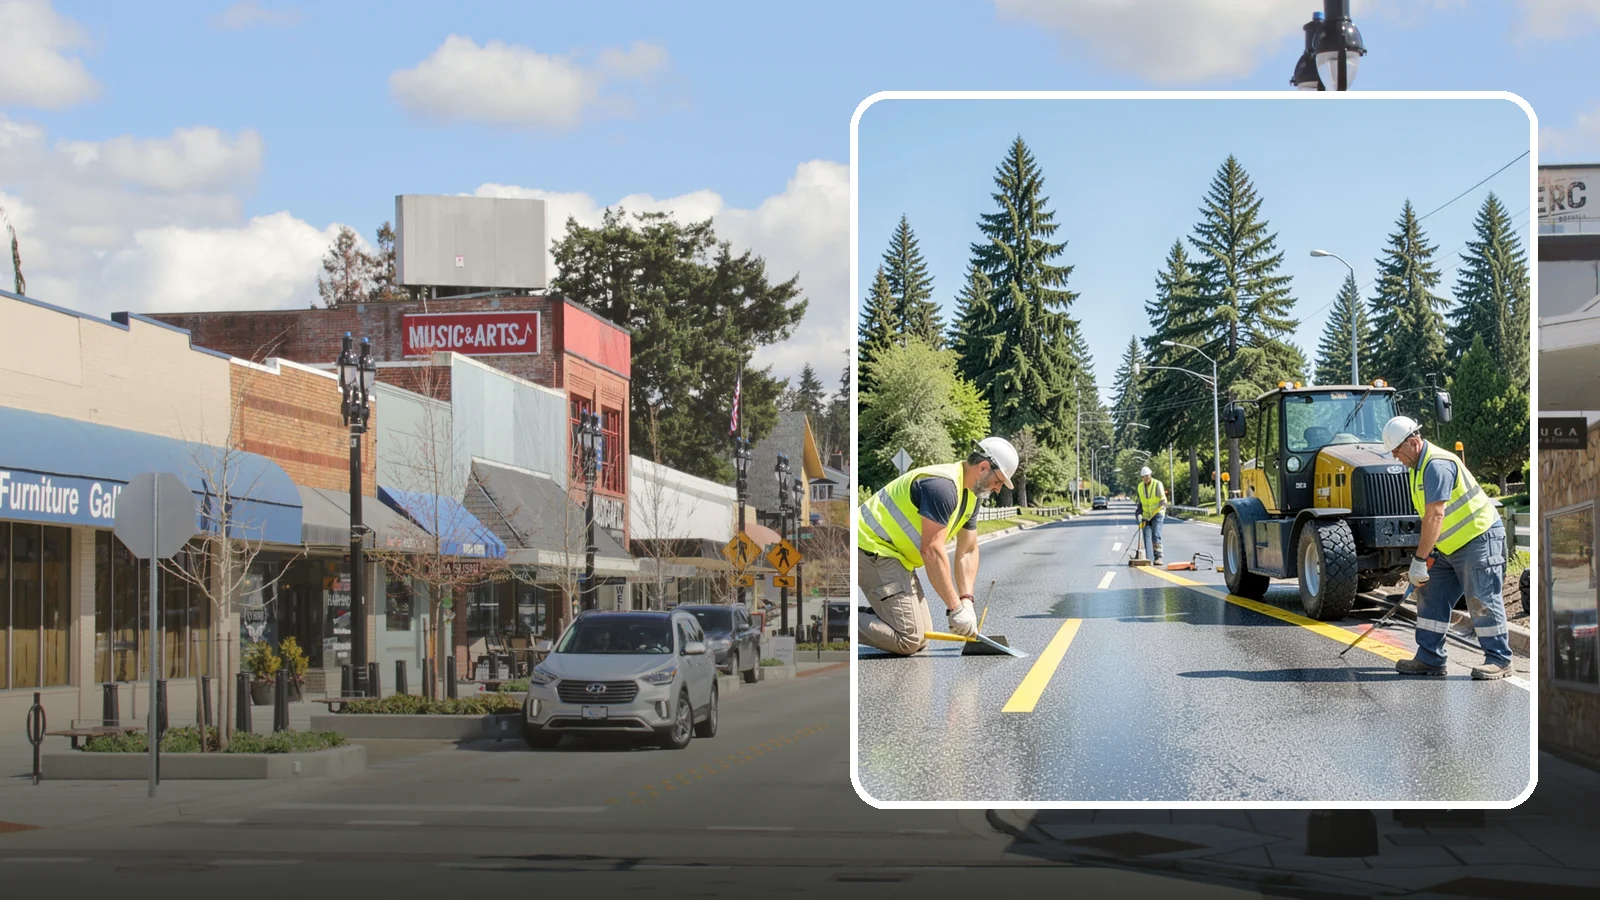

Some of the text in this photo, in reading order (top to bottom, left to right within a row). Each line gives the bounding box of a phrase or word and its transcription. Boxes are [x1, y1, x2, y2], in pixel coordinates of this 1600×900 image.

[1540, 427, 1577, 437] UGA
[0, 471, 121, 519] Furniture Gal
[453, 563, 478, 574] SUSHI
